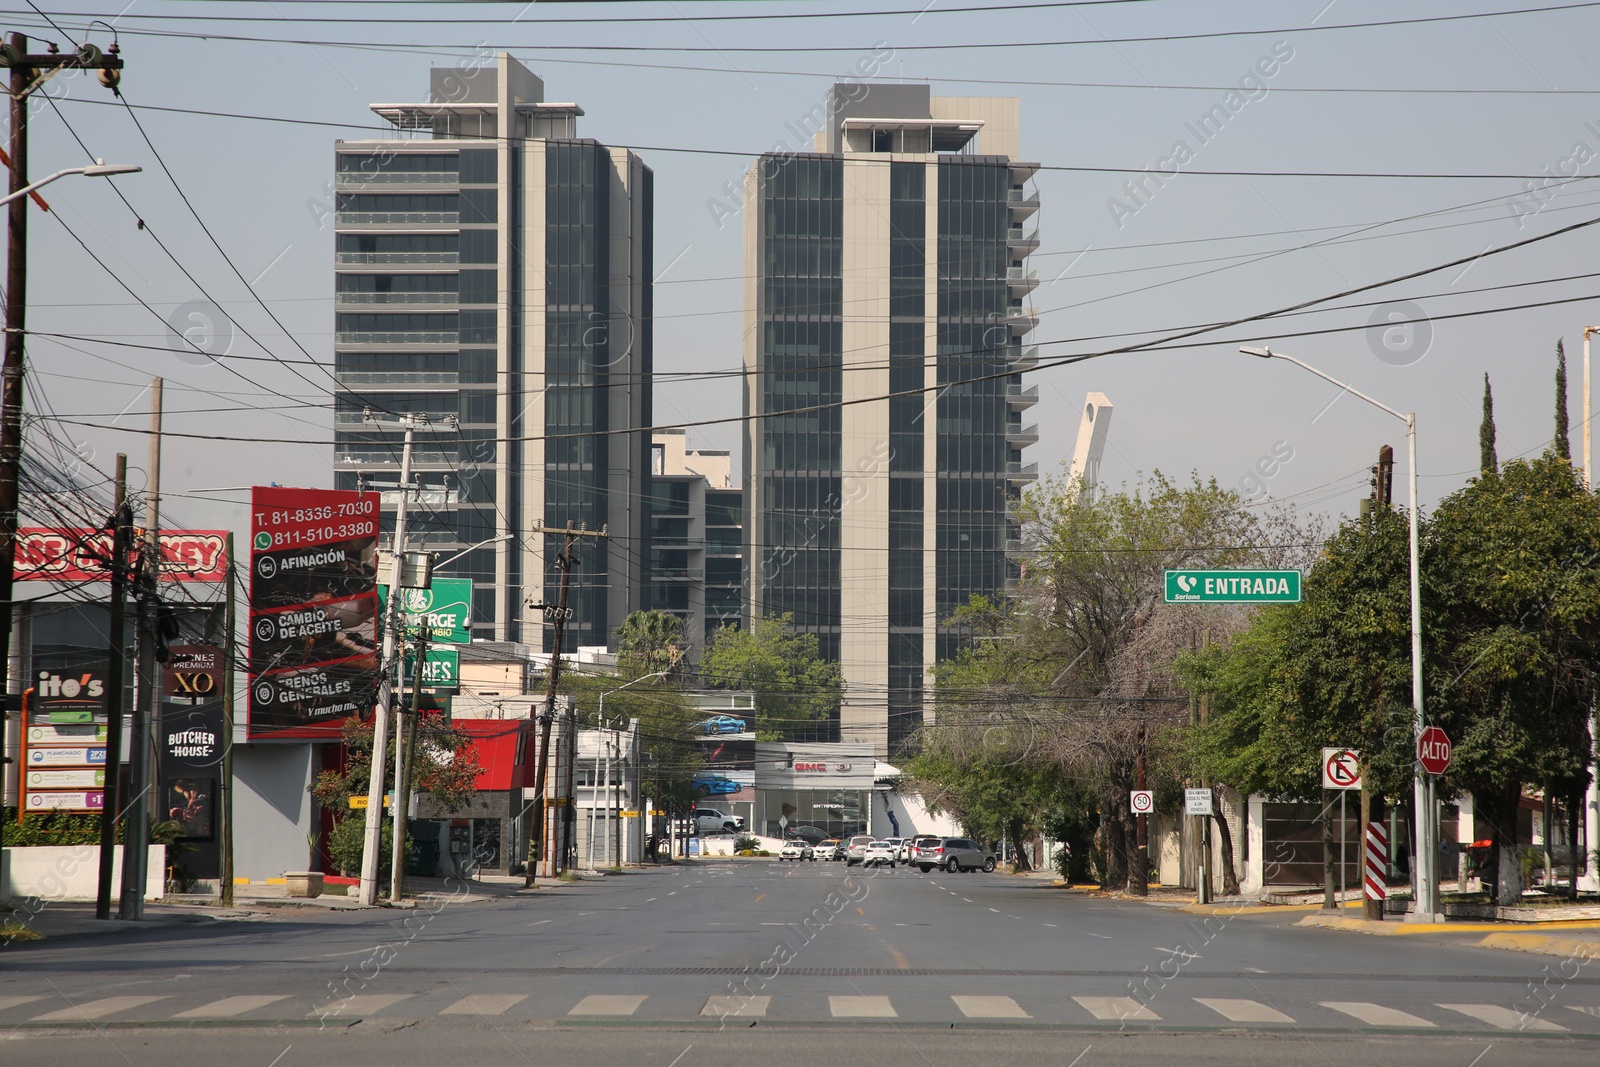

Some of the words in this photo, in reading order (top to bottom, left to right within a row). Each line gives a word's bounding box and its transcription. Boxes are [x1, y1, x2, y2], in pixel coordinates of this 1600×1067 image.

[255, 513, 268, 526] T.
[272, 501, 373, 525] 81-8336-7030
[275, 521, 373, 545] 811-510-3380
[281, 549, 346, 571] AFINACIÓN
[1205, 578, 1289, 595] ENTRADA
[279, 609, 326, 627] CAMBIO
[280, 628, 296, 639] DE
[299, 619, 342, 636] ACEITE
[39, 671, 104, 698] ito's
[173, 672, 214, 693] XO
[308, 707, 315, 716] Y
[314, 703, 342, 716] mucho
[168, 731, 215, 745] BUTCHER
[1421, 741, 1449, 761] ALTO
[795, 763, 827, 771] GMC
[1137, 796, 1148, 805] 50
